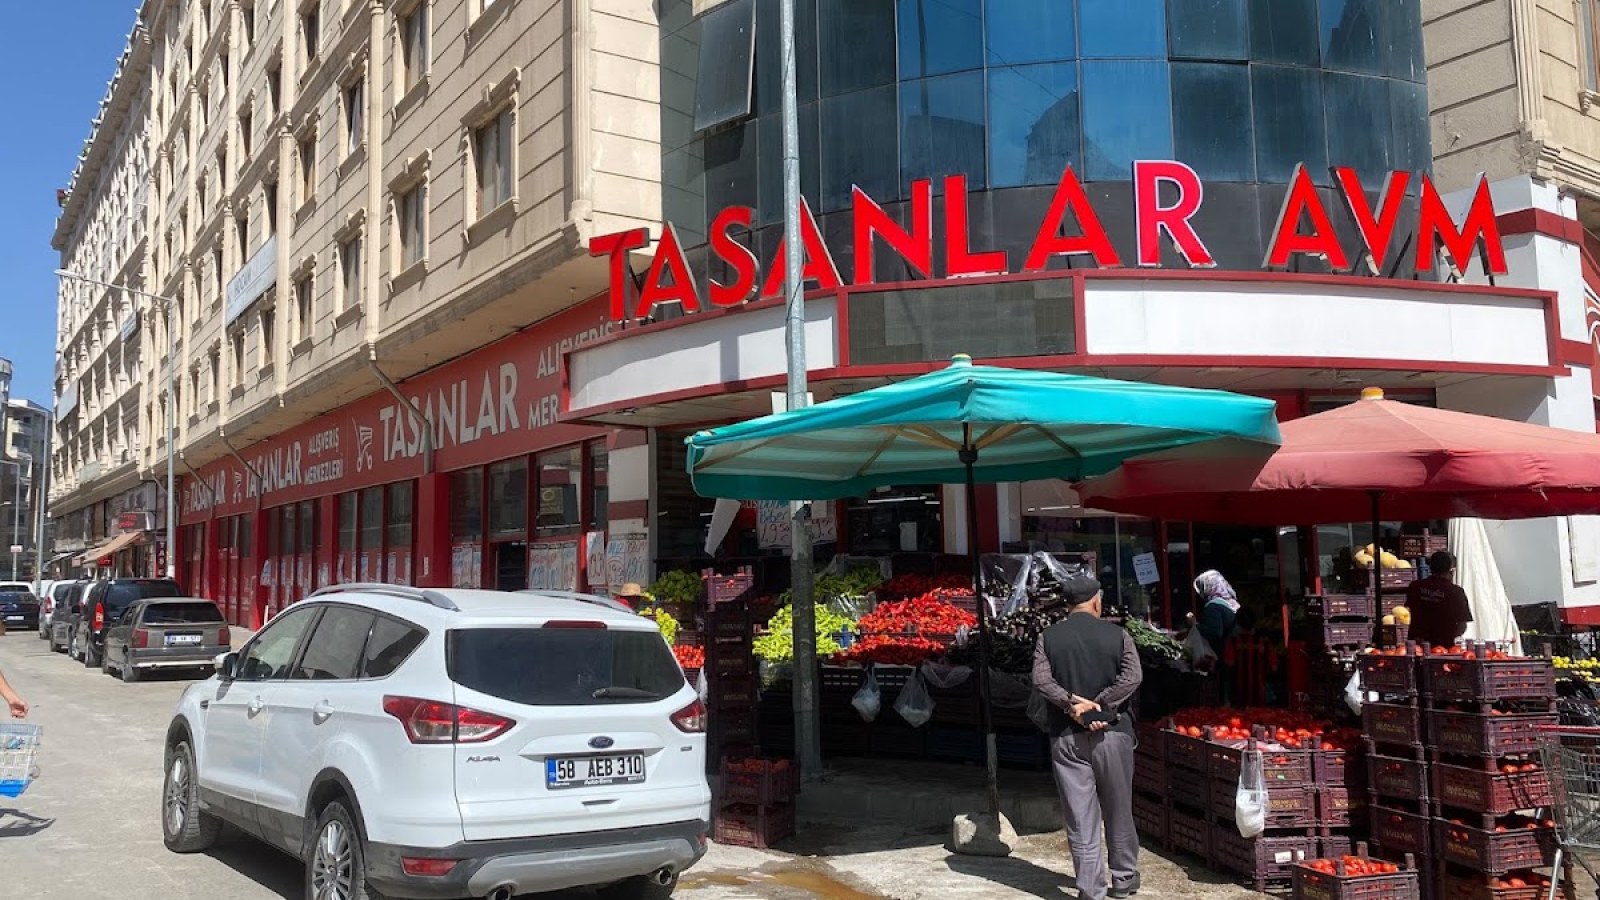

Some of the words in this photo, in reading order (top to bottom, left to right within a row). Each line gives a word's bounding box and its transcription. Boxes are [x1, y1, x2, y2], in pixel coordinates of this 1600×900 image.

[589, 160, 1217, 321] TASANLAR
[1262, 161, 1509, 277] AVM
[379, 361, 520, 463] TASANLAR
[245, 441, 302, 499] TASANLAR
[558, 760, 575, 780] 58
[588, 756, 613, 778] AEB
[617, 755, 642, 776] 310
